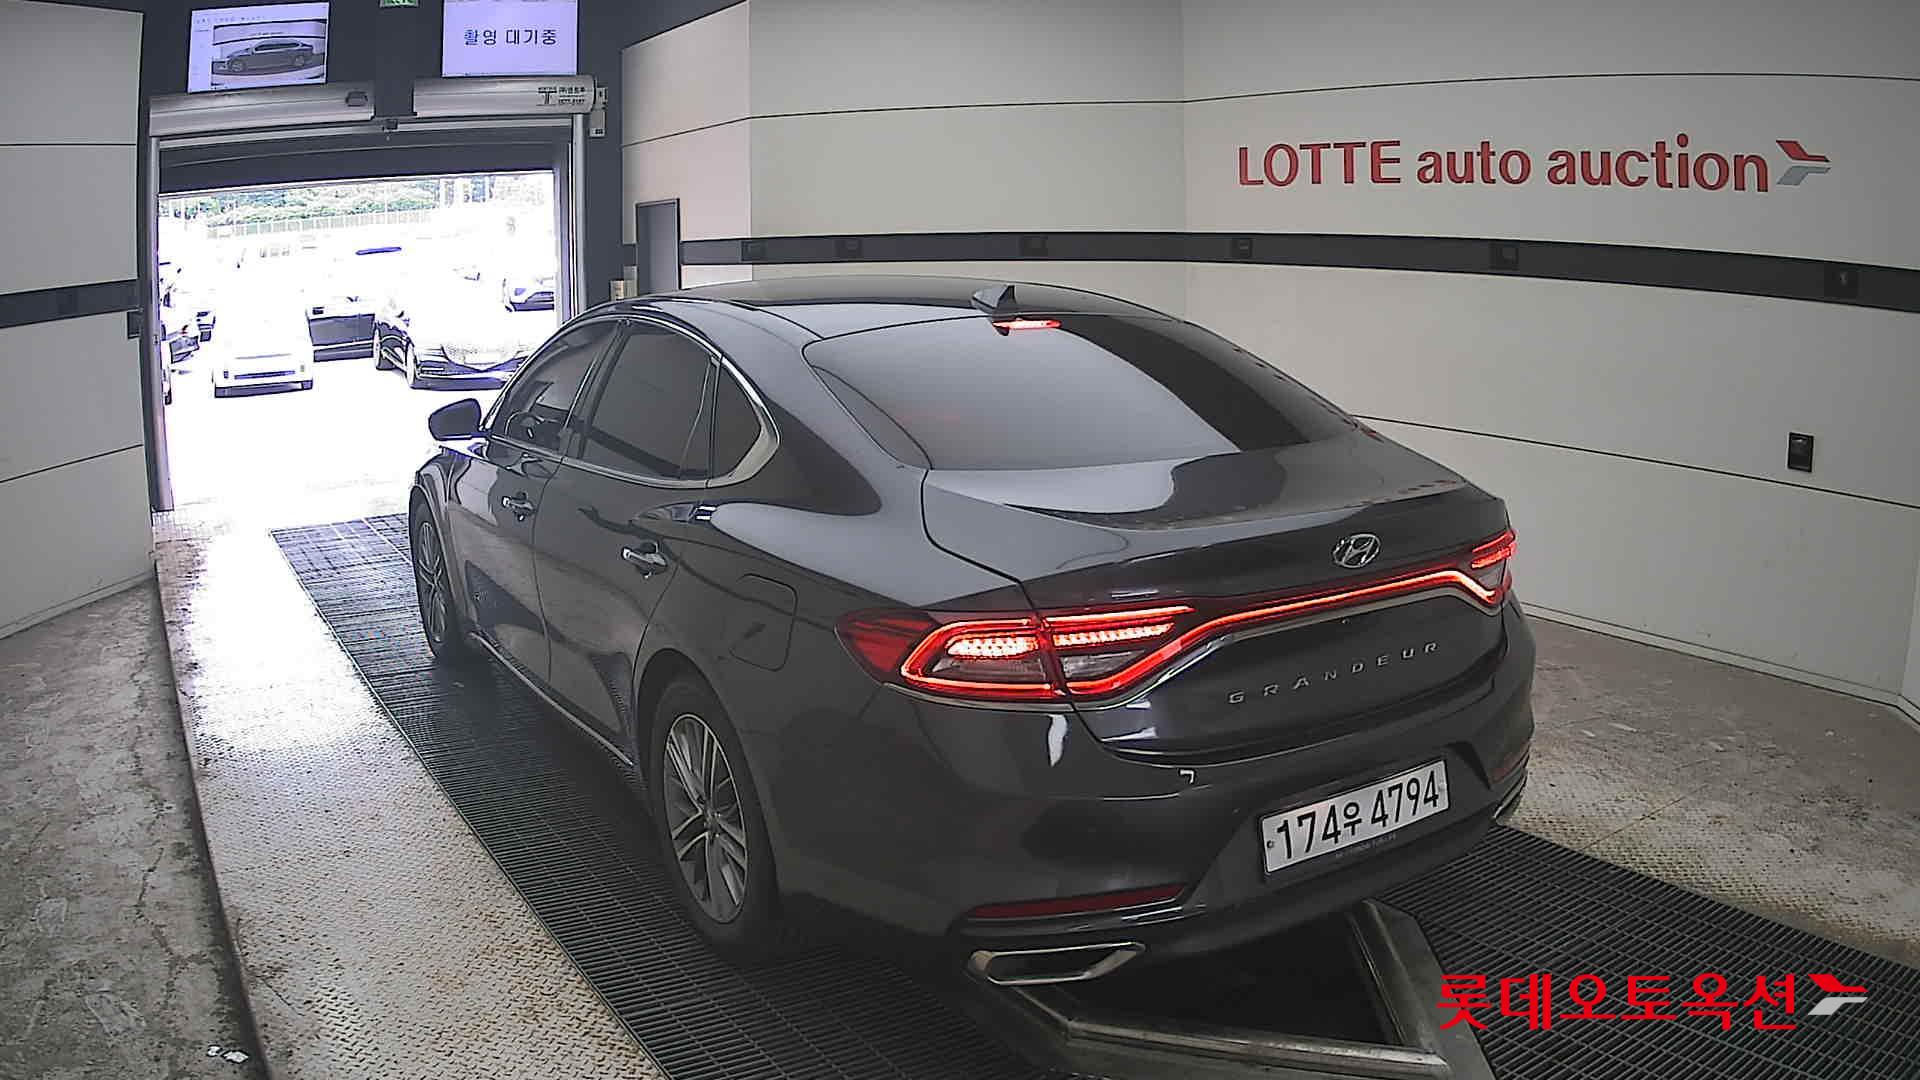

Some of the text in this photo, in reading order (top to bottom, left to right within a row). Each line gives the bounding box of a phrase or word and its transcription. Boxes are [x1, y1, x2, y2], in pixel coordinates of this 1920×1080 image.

[464, 29, 557, 46] 촬영 대기중
[1239, 133, 1769, 193] LOTTE auto auction
[1228, 642, 1438, 704] GRANDEUR
[1371, 770, 1439, 828] 4794
